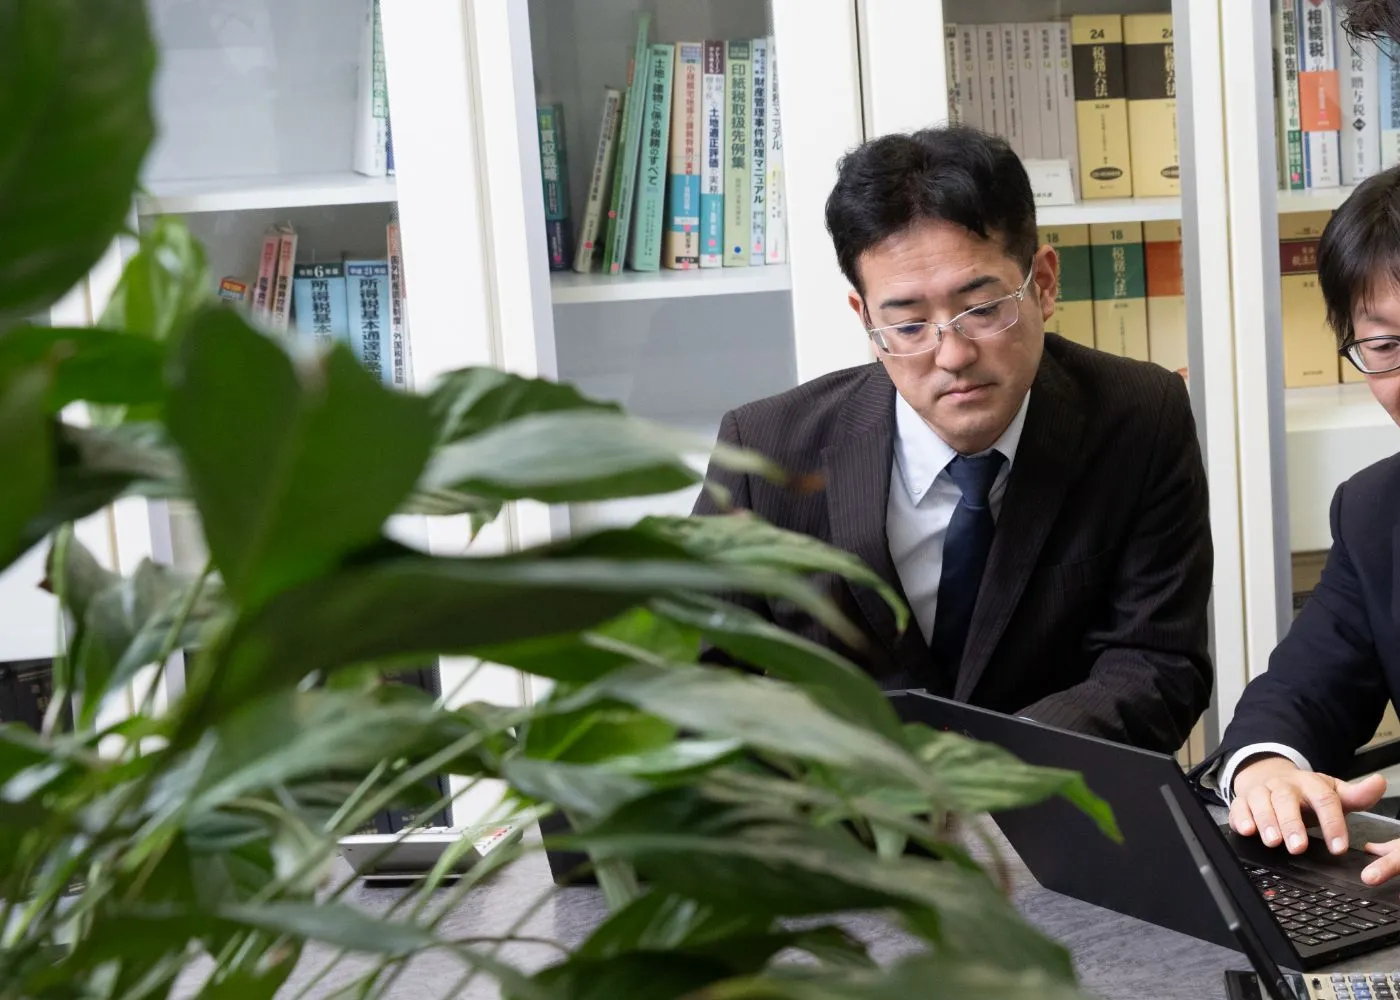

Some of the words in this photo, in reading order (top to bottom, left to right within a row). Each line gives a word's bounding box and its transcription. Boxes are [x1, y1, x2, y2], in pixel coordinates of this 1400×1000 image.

[1090, 29, 1105, 39] 24
[731, 63, 745, 169] 印紙税取扱先例集
[1046, 232, 1059, 243] 18
[1110, 230, 1124, 241] 18
